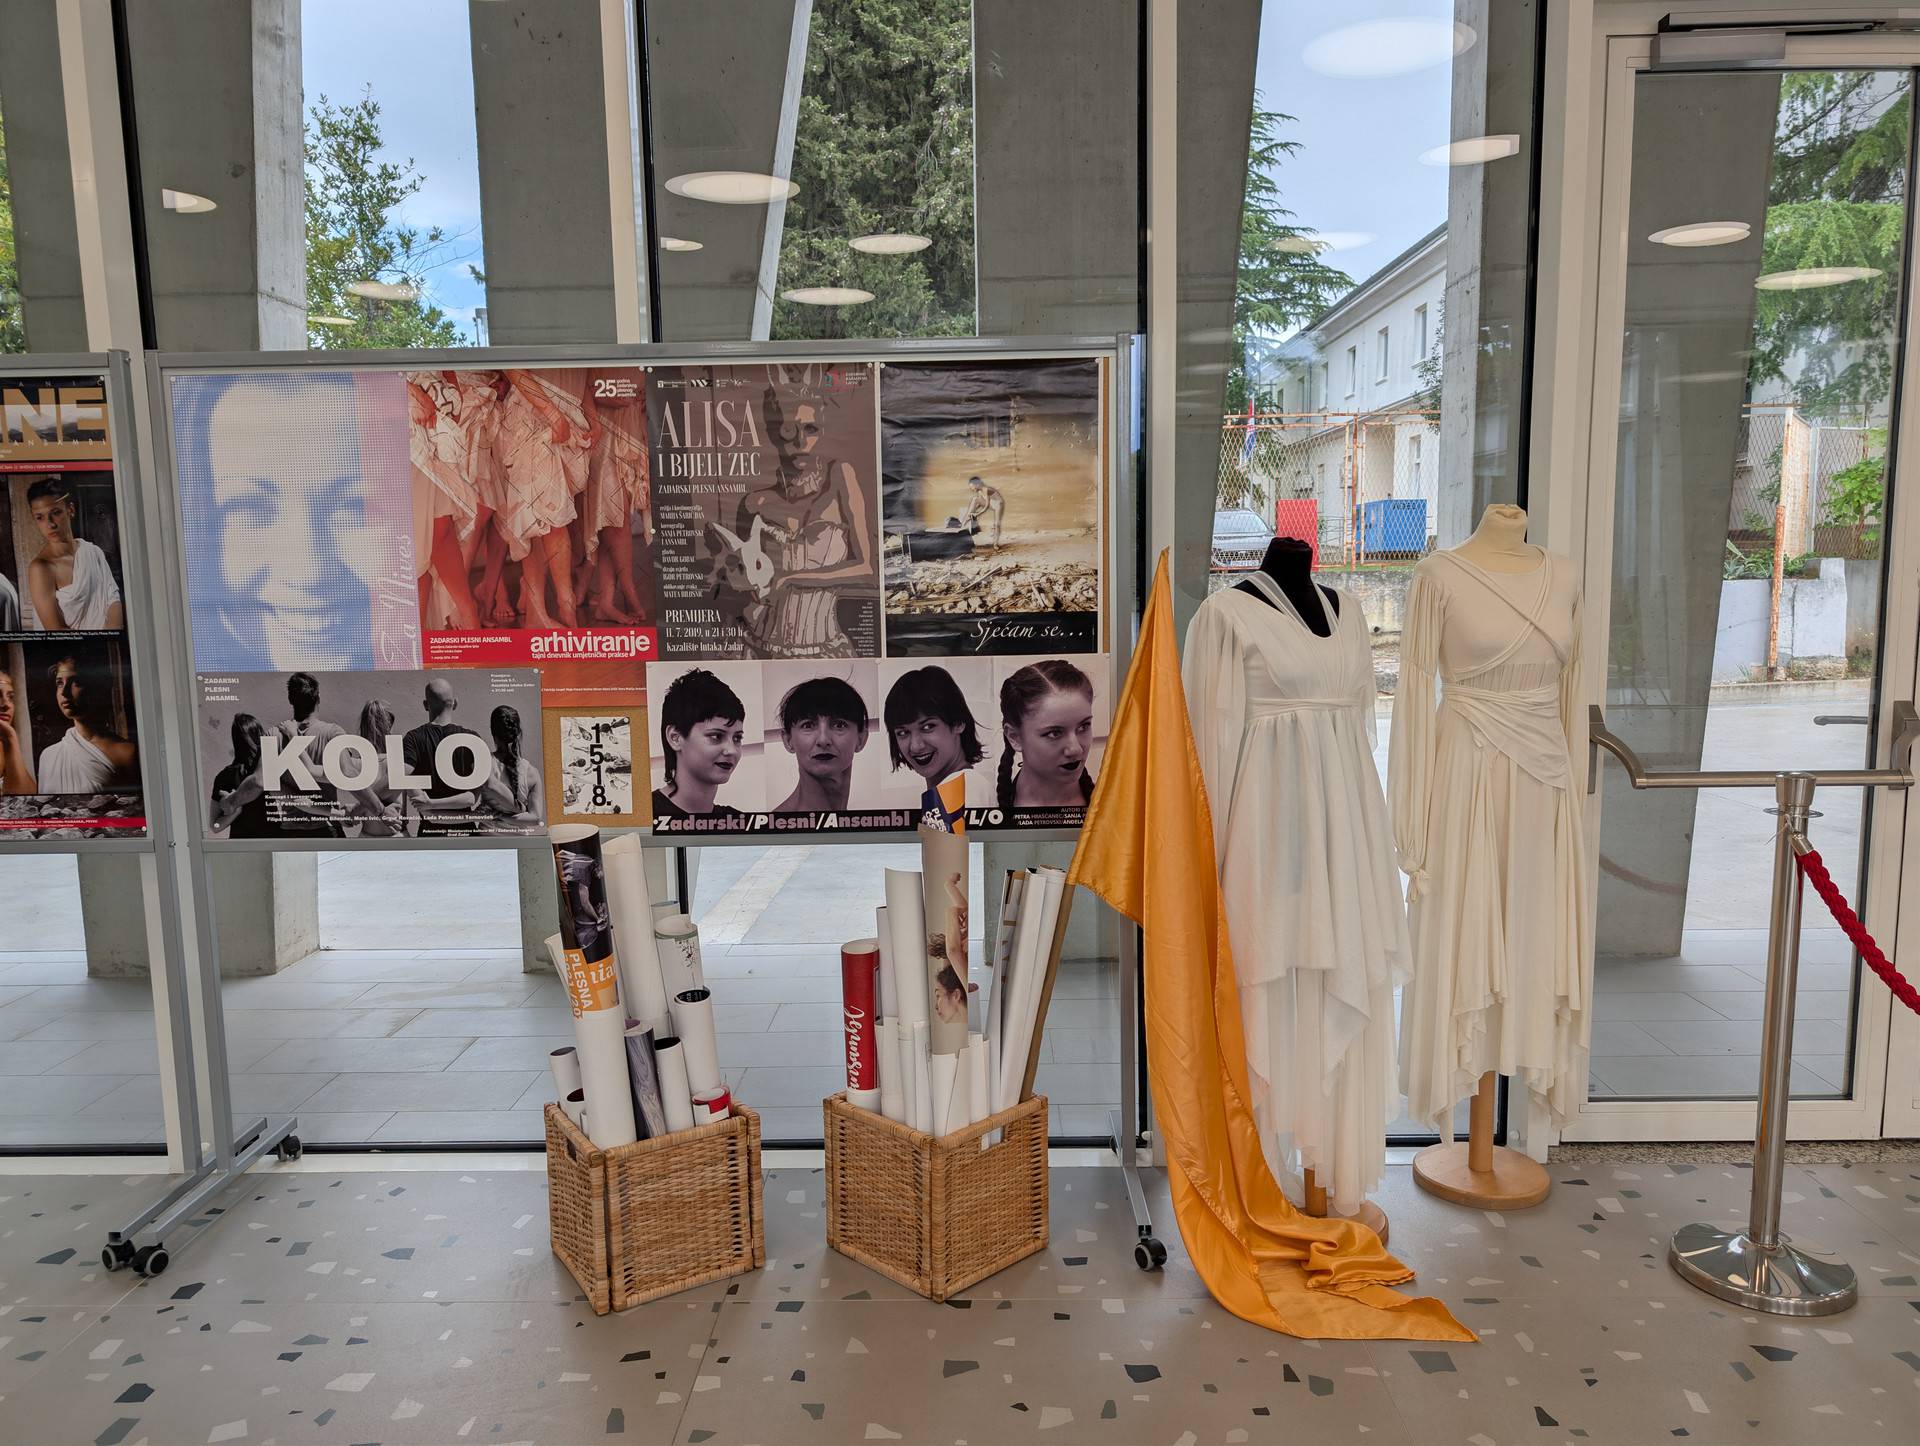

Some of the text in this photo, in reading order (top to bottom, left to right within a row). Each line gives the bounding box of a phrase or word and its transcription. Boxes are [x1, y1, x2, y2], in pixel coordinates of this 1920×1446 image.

[594, 379, 617, 398] 25
[0, 388, 106, 443] NE
[656, 400, 762, 449] ALISA
[658, 451, 761, 480] I BIJELI ZEC
[658, 483, 747, 494] ZADARSKI PLESNI ANSAMBL
[665, 609, 722, 624] PREMIJERA
[530, 630, 650, 656] arhiviranje
[676, 627, 683, 637] 7.
[683, 627, 704, 637] 2019.
[705, 629, 710, 637] u
[711, 627, 719, 637] 21
[725, 627, 737, 637] 30
[970, 618, 1037, 652] Sjećam
[546, 651, 572, 659] dnevnik
[572, 651, 607, 659] umjetničke
[607, 651, 629, 659] prakse
[666, 641, 745, 652] Kazalište lutaka Zadar
[260, 733, 492, 791] KOLO
[569, 953, 593, 1008] PLESNA
